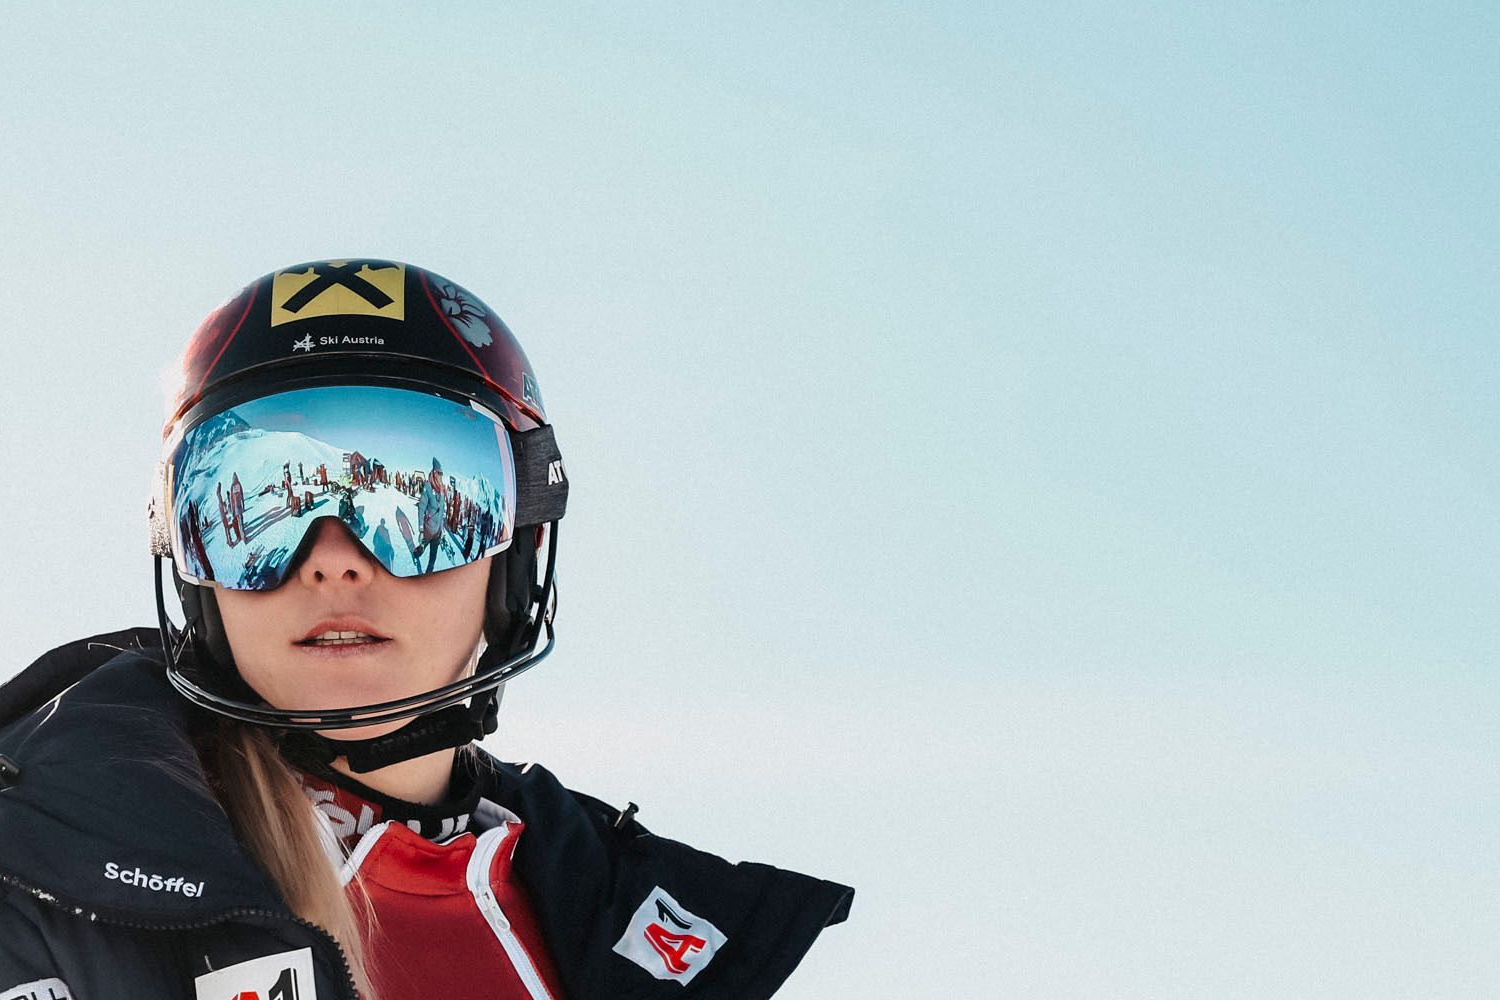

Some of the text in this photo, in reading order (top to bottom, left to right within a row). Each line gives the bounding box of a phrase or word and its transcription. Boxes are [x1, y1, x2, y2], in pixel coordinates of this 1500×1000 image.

[319, 335, 386, 346] Ski Austria
[643, 897, 708, 975] A1
